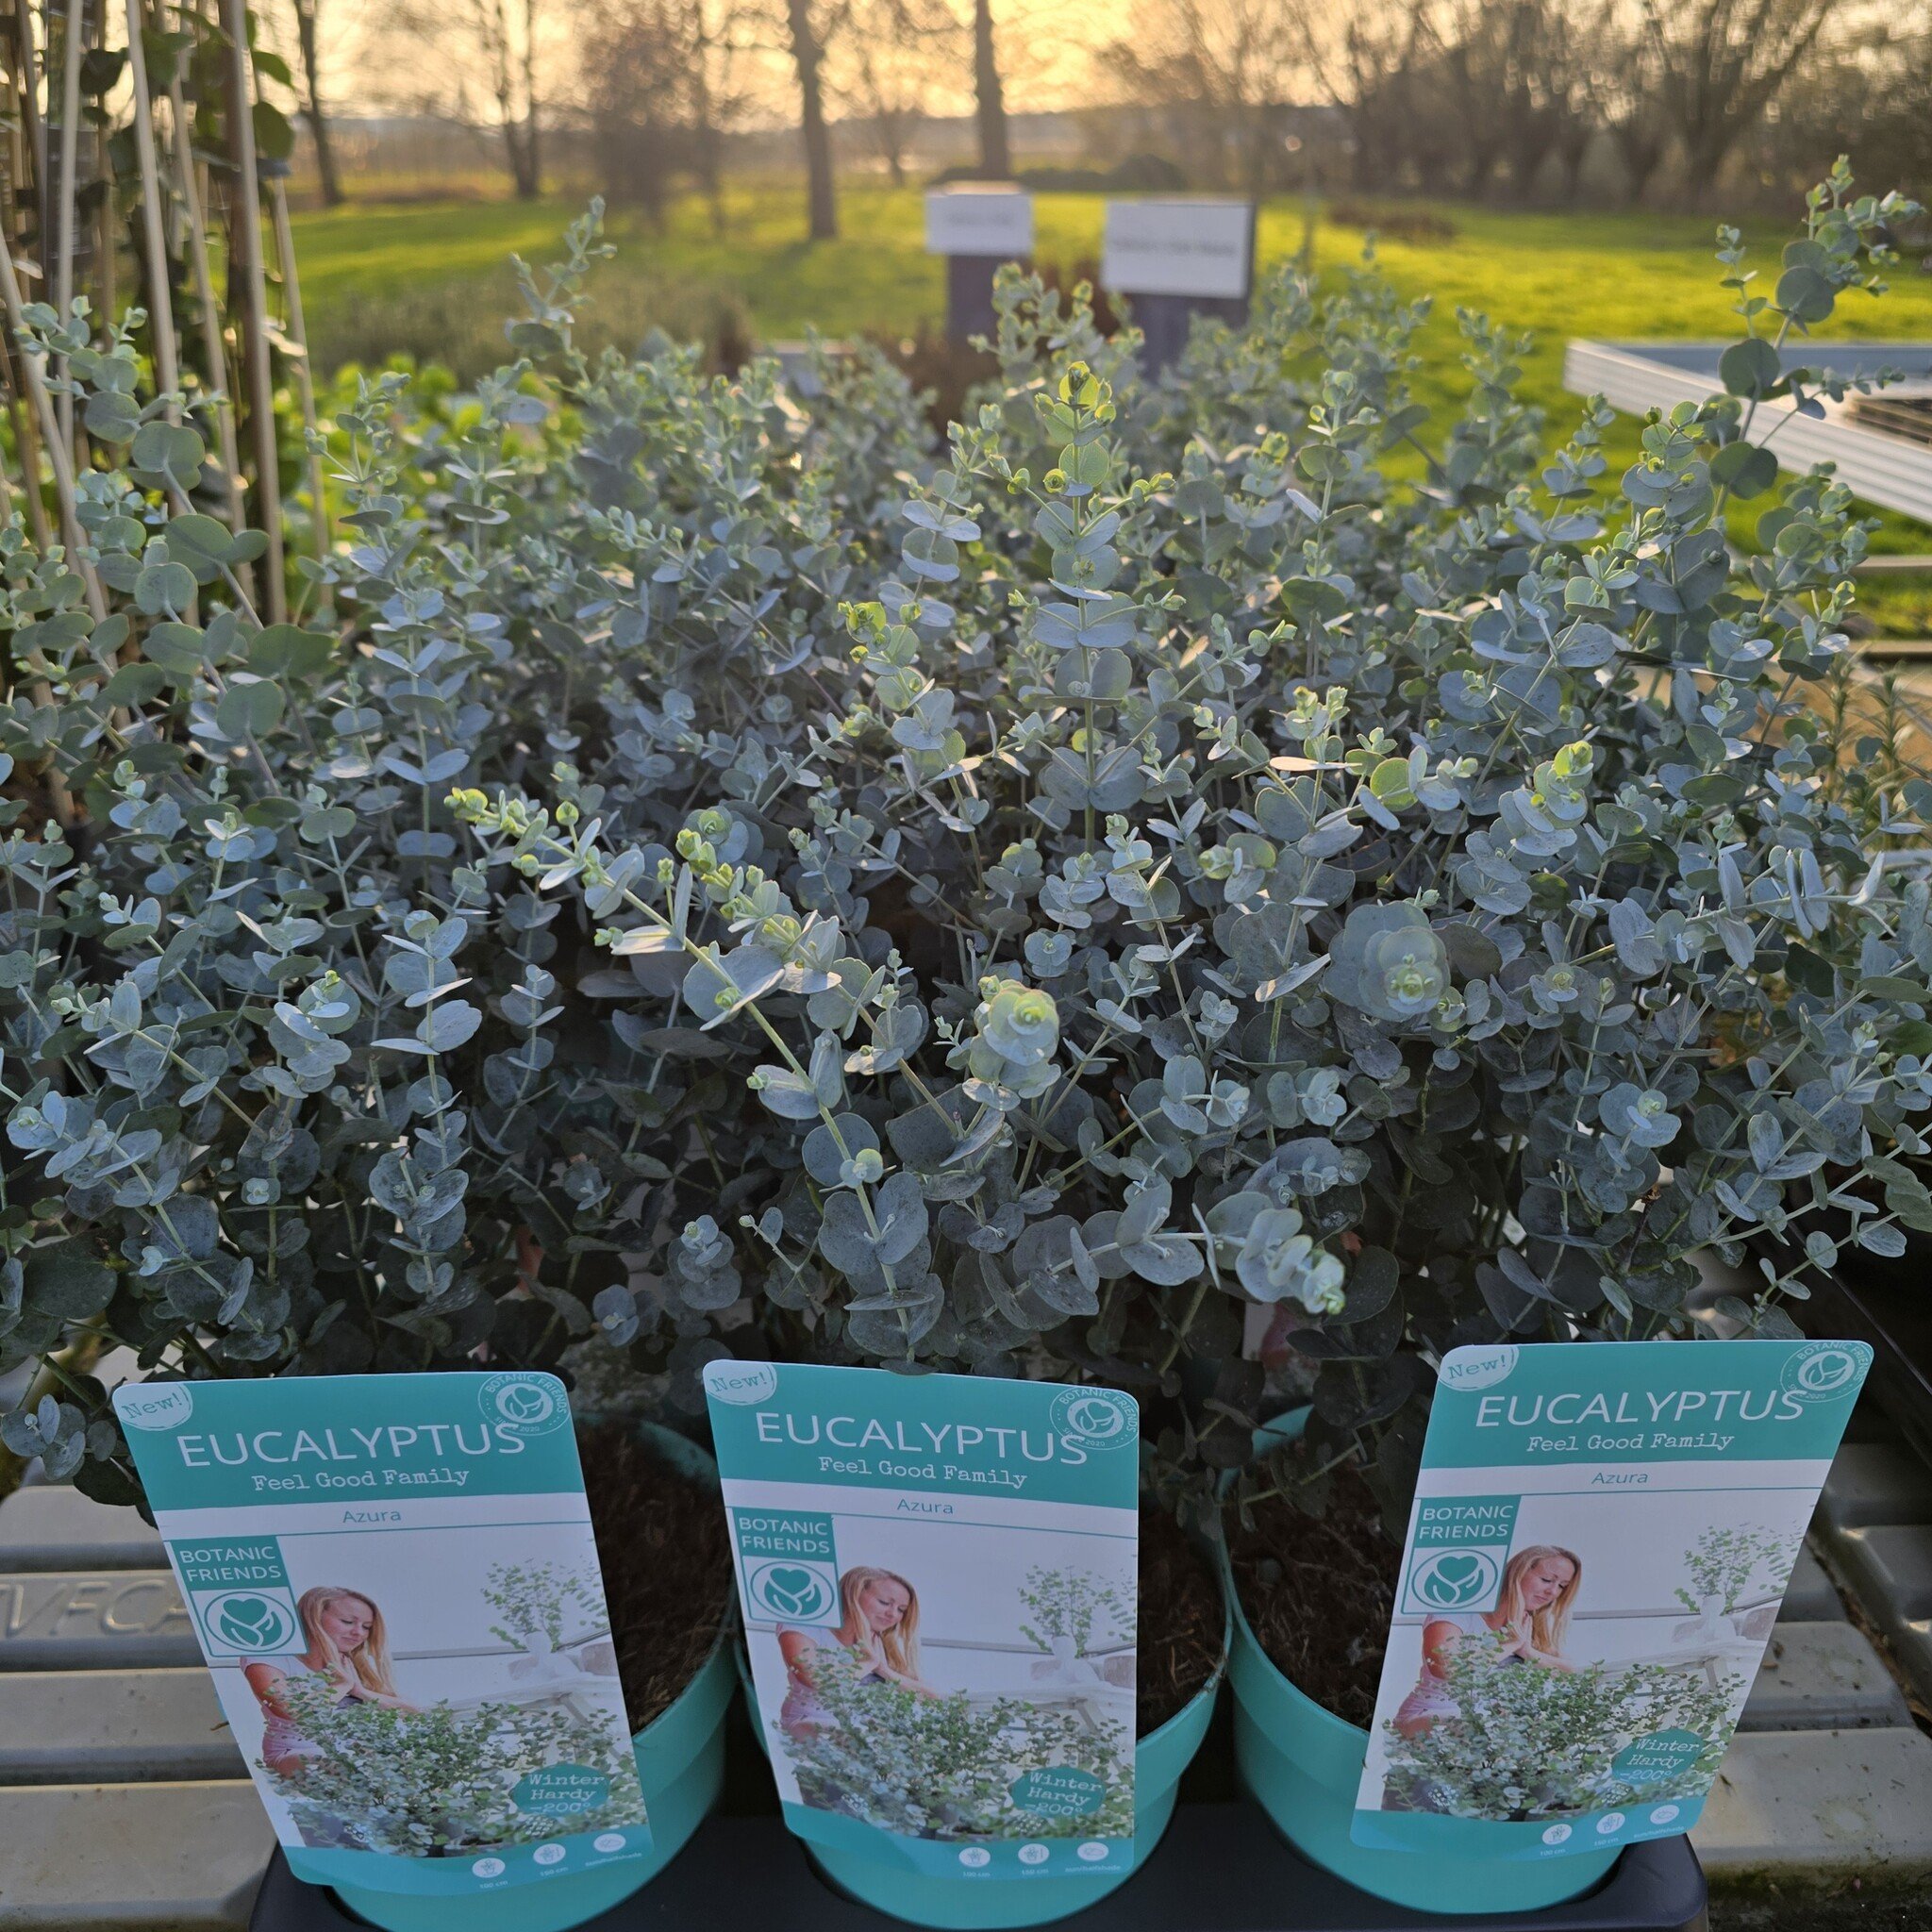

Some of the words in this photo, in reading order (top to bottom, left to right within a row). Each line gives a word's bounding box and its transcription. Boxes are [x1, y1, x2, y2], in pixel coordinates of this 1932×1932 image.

[1796, 1341, 1852, 1359] BOTANIC
[1448, 1355, 1506, 1380] New!
[485, 1374, 535, 1392] BOTANIC
[709, 1372, 767, 1392] New!
[122, 1392, 183, 1419] New!
[1058, 1388, 1111, 1405] BOTANIC
[1475, 1390, 1807, 1427] EUCALYPTUS
[176, 1424, 525, 1467] EUCALYPTUS
[756, 1412, 1088, 1465] EUCALYPTUS
[1526, 1436, 1579, 1452] Feel
[1587, 1434, 1643, 1450] Good
[1650, 1432, 1735, 1451] Family
[251, 1474, 310, 1491] Feel
[316, 1470, 377, 1489] Good
[382, 1468, 470, 1487] Family
[819, 1457, 873, 1474] Feel
[878, 1460, 936, 1479] Good
[943, 1465, 1027, 1490] Family
[1591, 1472, 1648, 1484] Azura
[897, 1498, 954, 1514] Azura
[1423, 1505, 1514, 1521] BOTANIC
[342, 1509, 402, 1524] Azura
[739, 1517, 827, 1535] BOTANIC
[1419, 1524, 1508, 1540] FRIENDS
[741, 1536, 830, 1553] FRIENDS
[179, 1546, 275, 1563] BOTANIC
[186, 1565, 282, 1582] FRIENDS
[1635, 1739, 1699, 1752] Winter
[1626, 1754, 1685, 1769] Hardy
[529, 1774, 605, 1786] Winter
[1029, 1772, 1102, 1791] Winter
[530, 1789, 596, 1802] Hardy
[1026, 1787, 1091, 1806] Hardy
